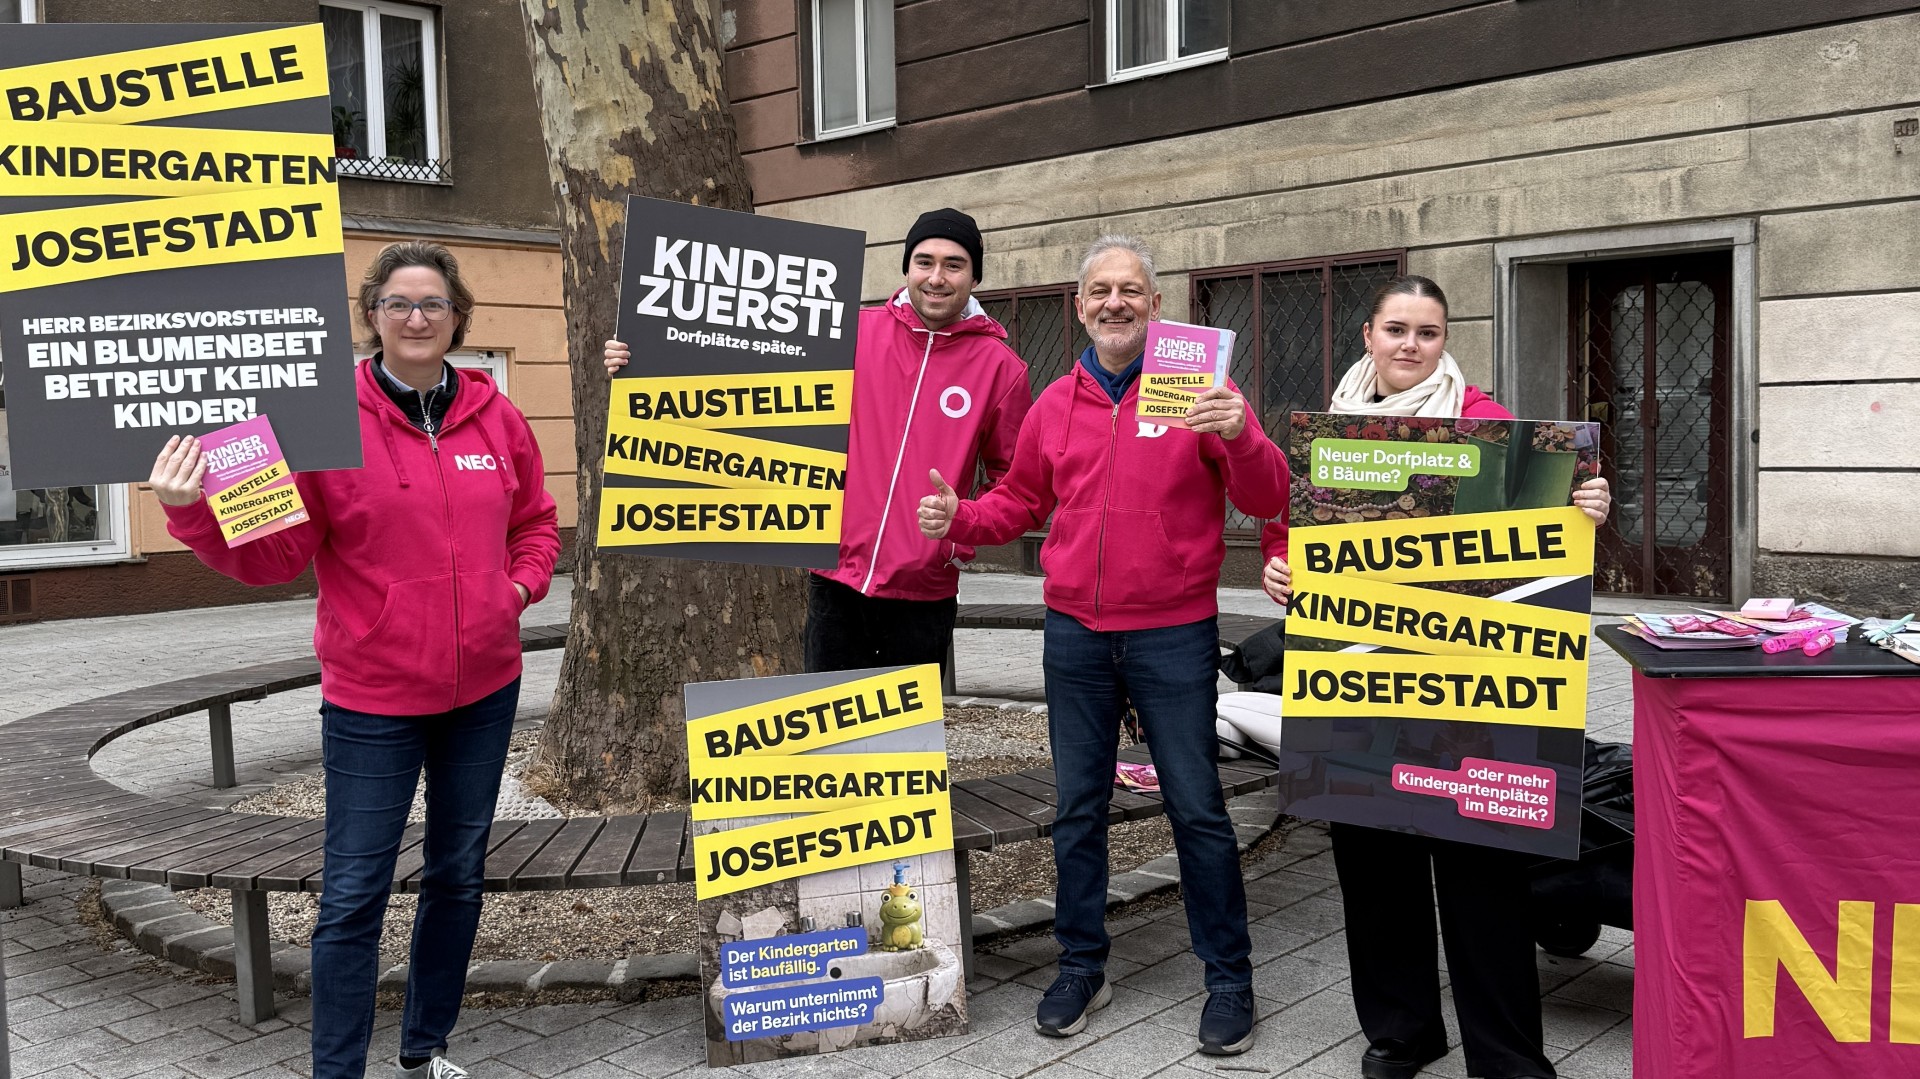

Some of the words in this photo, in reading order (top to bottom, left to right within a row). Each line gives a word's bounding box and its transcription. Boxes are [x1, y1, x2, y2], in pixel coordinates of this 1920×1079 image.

[6, 45, 304, 121] BAUSTELLE
[0, 145, 336, 185] KINDERGARTEN
[11, 203, 323, 271] JOSEFSTADT
[653, 235, 838, 300] KINDER
[22, 317, 86, 336] HERR
[90, 307, 325, 333] BEZIRKSVORSTEHER,
[636, 275, 845, 340] ZUERST!
[27, 340, 88, 368] EIN
[94, 330, 328, 364] BLUMENBEET
[666, 326, 749, 350] Dorfplätze
[752, 338, 806, 357] später.
[1154, 347, 1206, 362] ZUERST!
[1158, 337, 1205, 352] KINDER
[44, 368, 207, 400] BETREUT
[215, 362, 318, 391] KEINE
[1145, 387, 1197, 404] KINDERGART
[1150, 376, 1205, 385] BAUSTELLE
[113, 397, 257, 429] KINDER!
[628, 384, 835, 421] BAUSTELLE
[1145, 405, 1188, 414] JOSEFSTA
[206, 435, 262, 462] KINDER
[208, 444, 269, 473] ZUERST!
[607, 433, 846, 491] KINDERGARTEN
[1318, 447, 1370, 465] Neuer
[1374, 449, 1454, 470] Dorfplatz
[1458, 454, 1472, 469] &
[219, 467, 280, 503] BAUSTELLE
[1318, 464, 1328, 480] 8
[1333, 464, 1401, 484] Bäume?
[219, 488, 293, 516] KINDERGARTEN
[231, 500, 294, 534] JOSEFSTADT
[284, 511, 305, 524] NEOS
[611, 504, 831, 532] JOSEFSTADT
[1305, 524, 1566, 574] BAUSTELLE
[1286, 591, 1587, 661] KINDERGARTEN
[1293, 669, 1567, 711] JOSEFSTADT
[704, 681, 923, 758] BAUSTELLE
[691, 769, 948, 804] KINDERGARTEN
[1399, 772, 1548, 805] Kindergartenplätze
[1467, 767, 1504, 782] oder
[1508, 772, 1549, 789] mehr
[1465, 797, 1484, 813] im
[1488, 801, 1548, 822] Bezirk?
[707, 809, 937, 881] JOSEFSTADT
[728, 948, 756, 965] Der
[758, 938, 858, 960] Kindergarten
[729, 967, 748, 982] ist
[751, 960, 821, 979] baufällig.
[731, 998, 786, 1017] Warum
[789, 985, 878, 1009] unternimmt
[732, 1018, 758, 1034] der
[761, 1012, 810, 1030] Bezirk
[813, 1003, 867, 1024] nichts?
